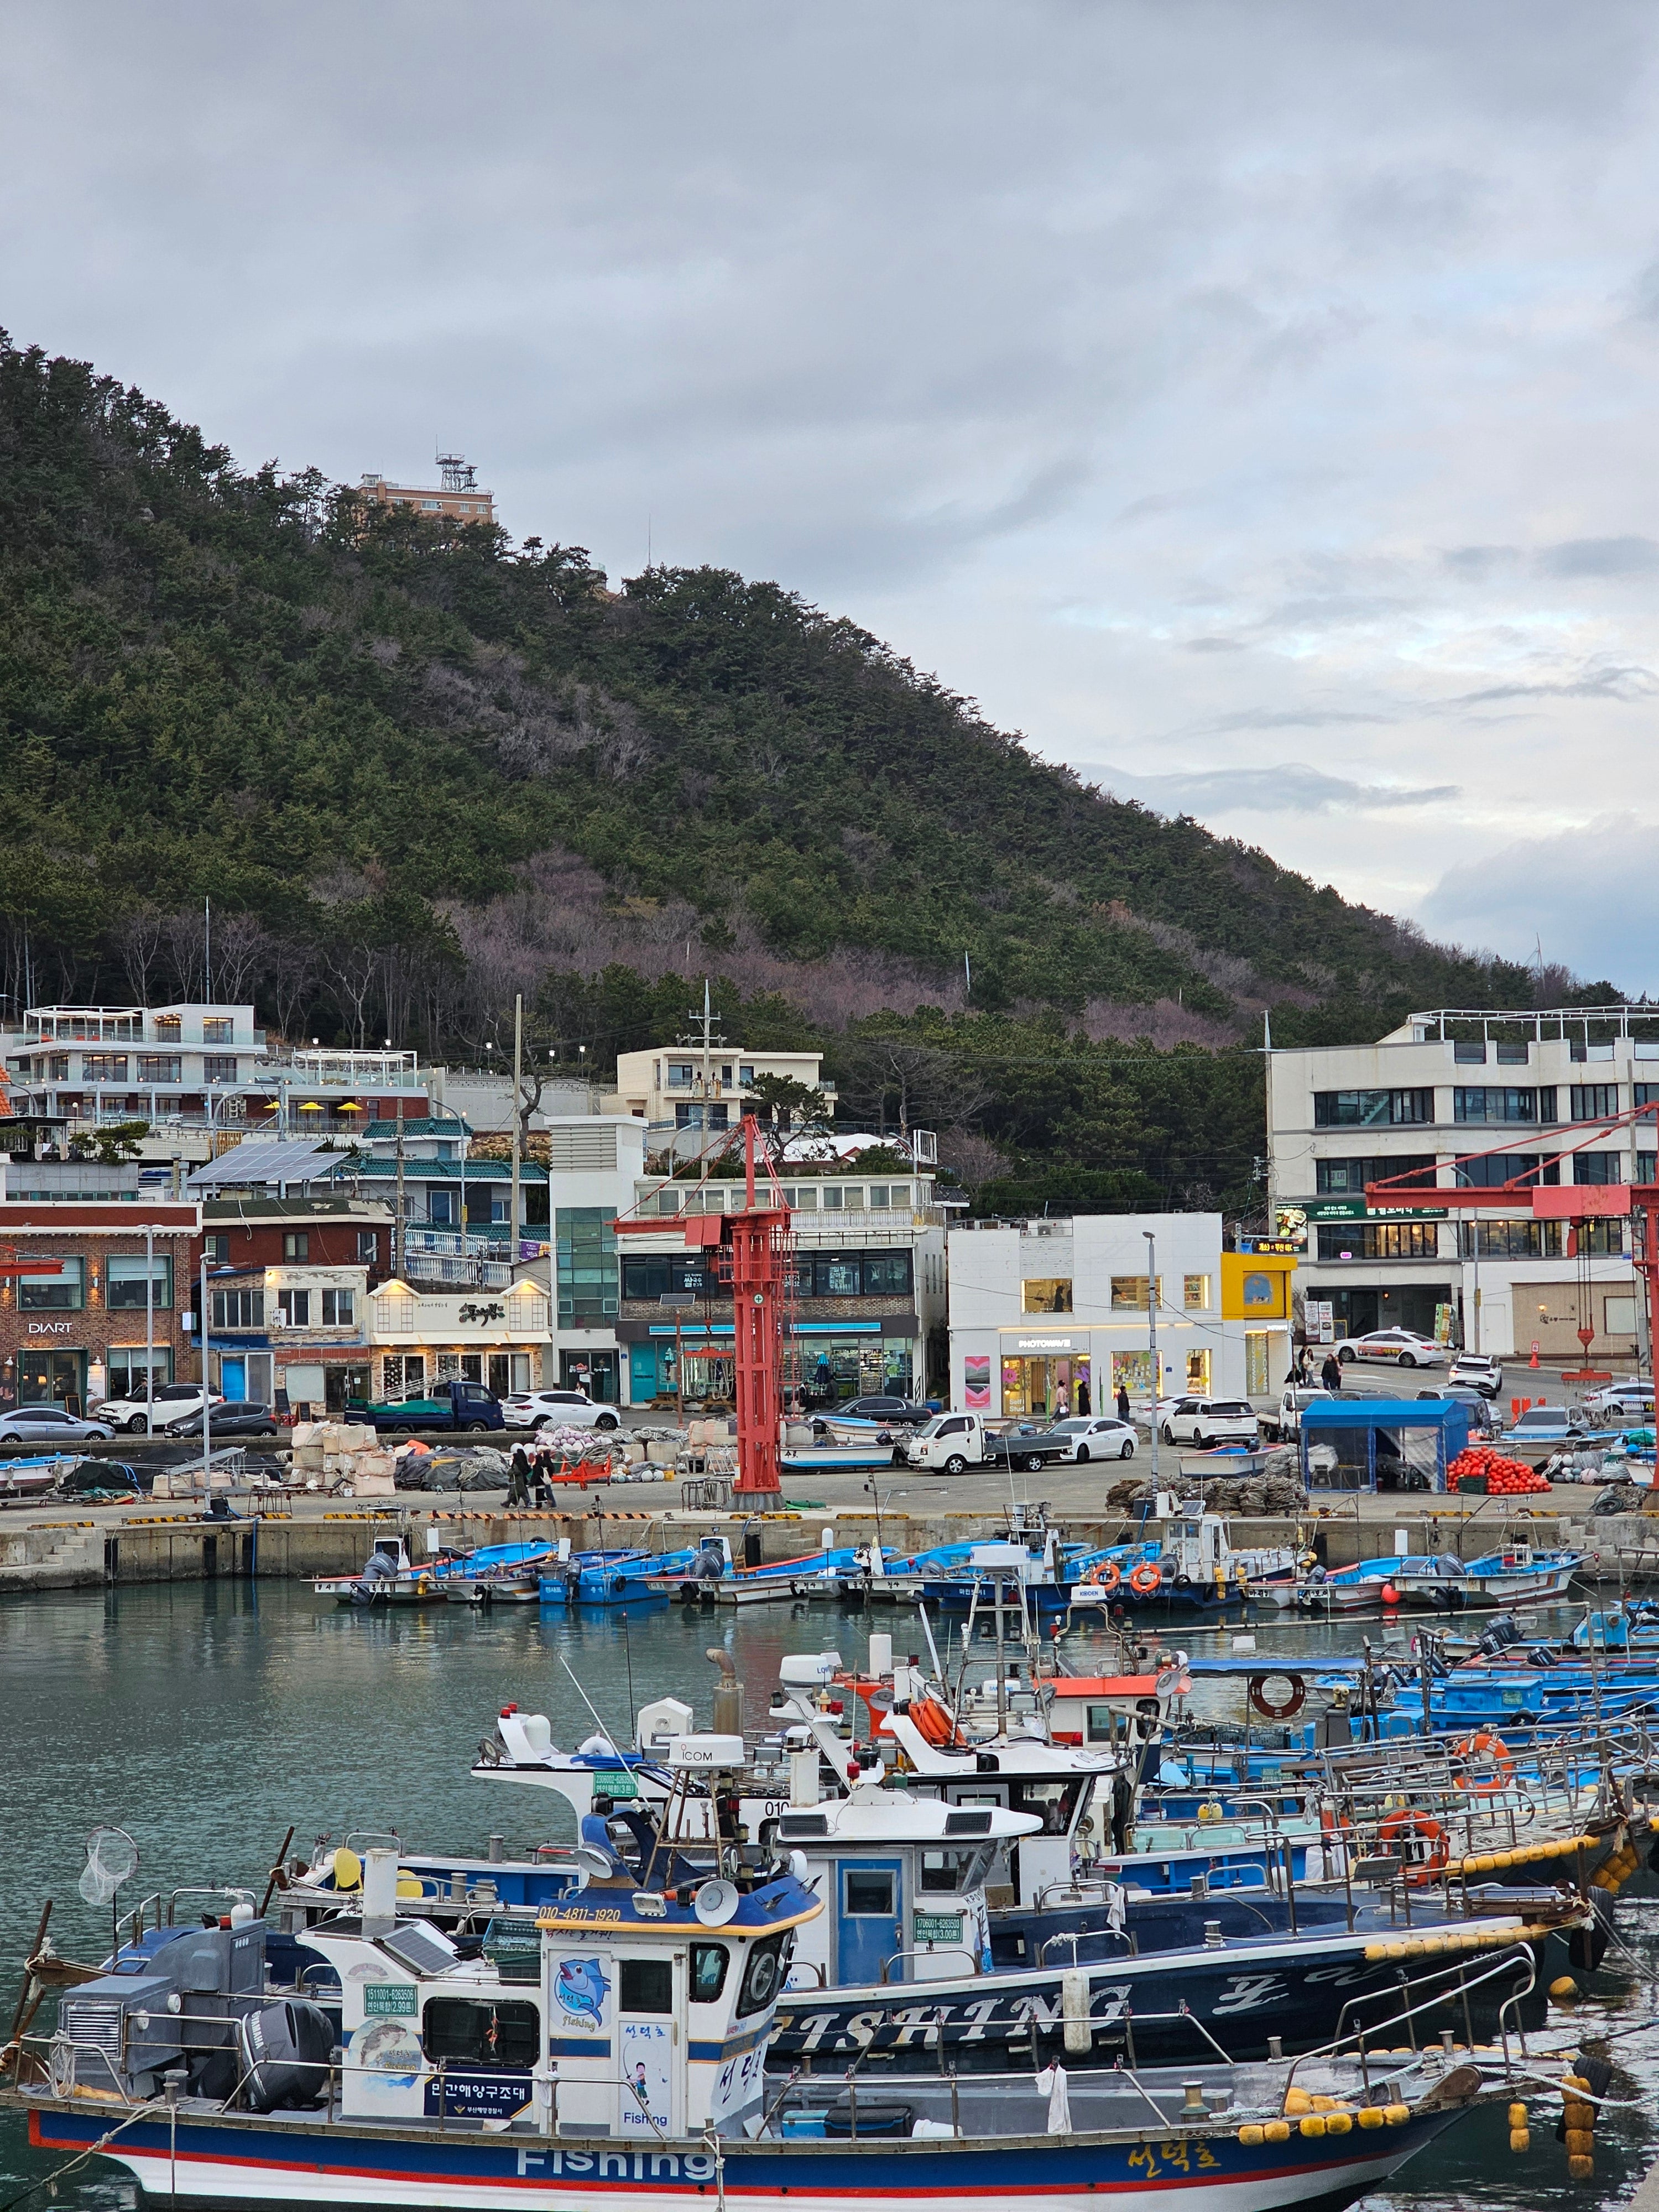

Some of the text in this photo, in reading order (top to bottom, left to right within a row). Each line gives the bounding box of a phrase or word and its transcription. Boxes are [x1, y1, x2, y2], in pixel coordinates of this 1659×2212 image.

[28, 1323, 72, 1333] DIART
[1019, 1339, 1071, 1348] PHOTOWAVE
[539, 1906, 620, 1922] 010-4811-1920
[367, 1988, 414, 2001] 1511001-6263506
[367, 2001, 414, 2013] 연안복합(2.99톤)
[251, 2017, 264, 2049] YAMAHA
[432, 2083, 525, 2101] 민간해양구조대
[467, 2106, 503, 2115] 부산해양경찰서
